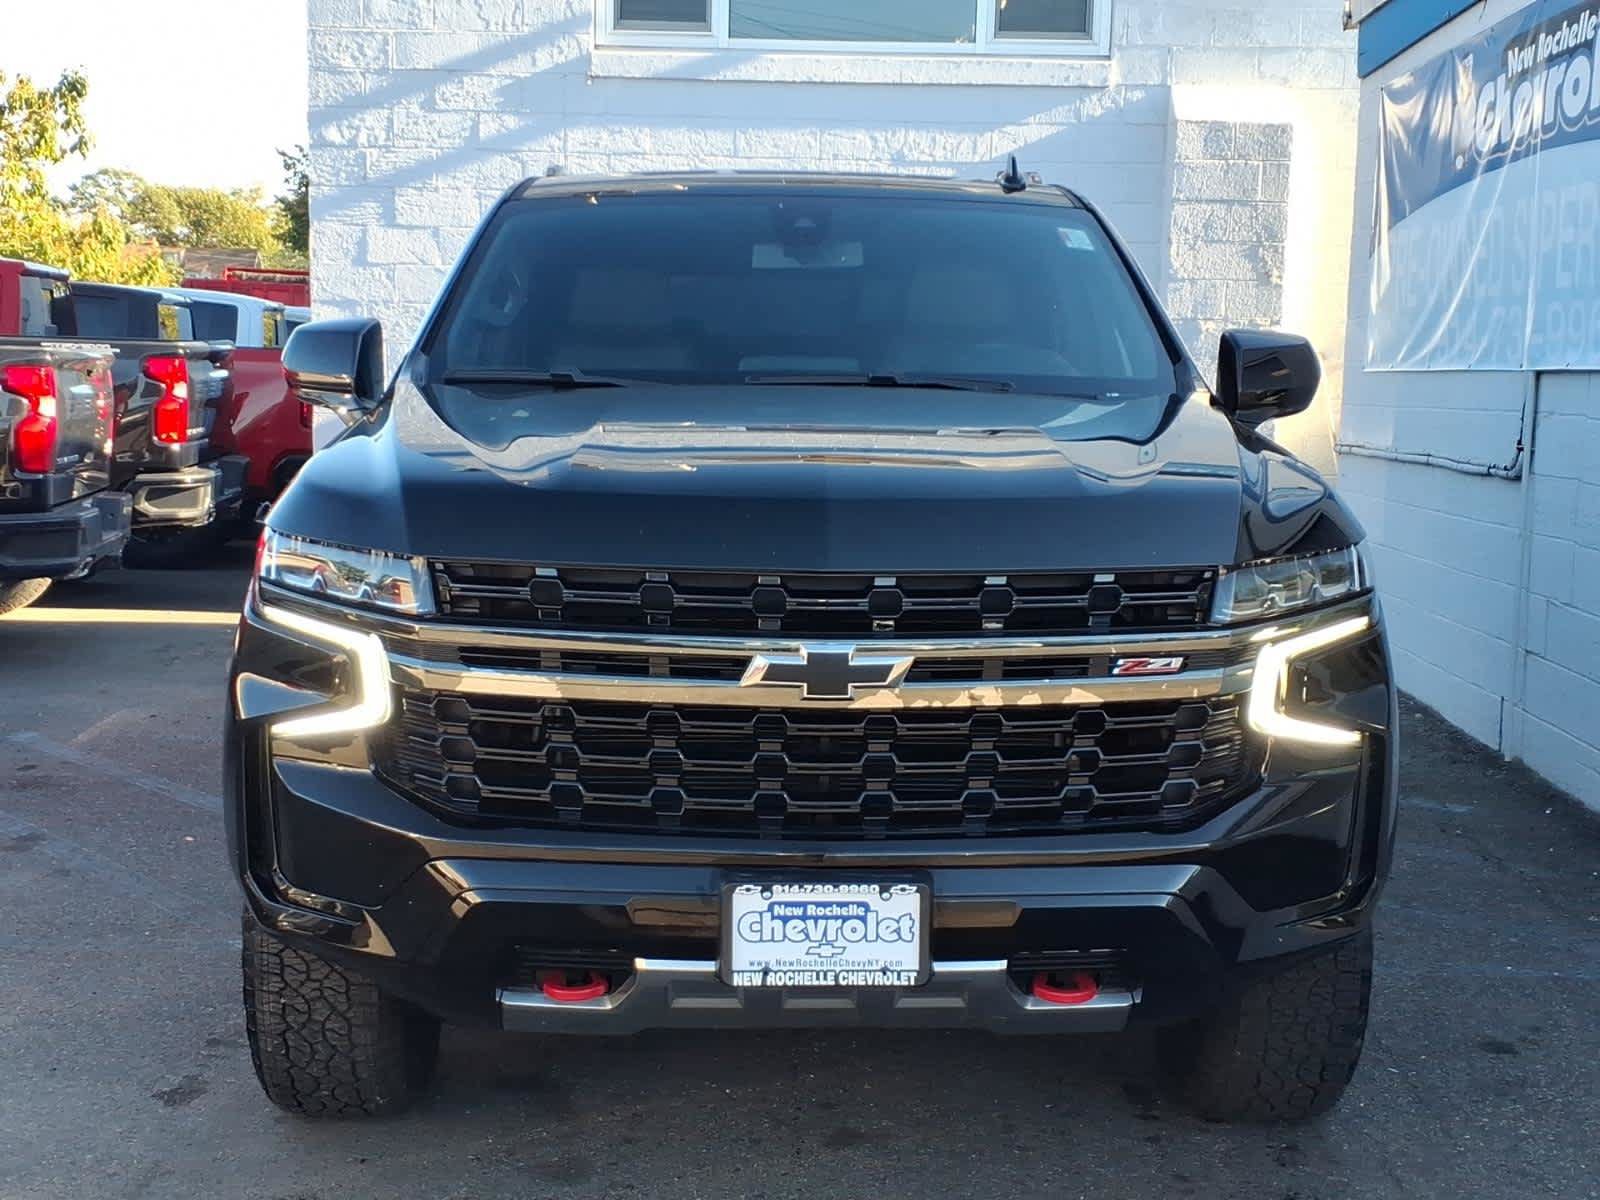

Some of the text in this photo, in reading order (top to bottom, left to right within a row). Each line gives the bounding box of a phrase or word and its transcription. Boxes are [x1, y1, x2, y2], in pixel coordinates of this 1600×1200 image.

[1507, 9, 1597, 78] New Rochelle
[774, 904, 865, 916] New Rochelle
[737, 911, 915, 943] Chevrolet
[733, 971, 917, 986] NEW ROCHELLE CHEVROLET
